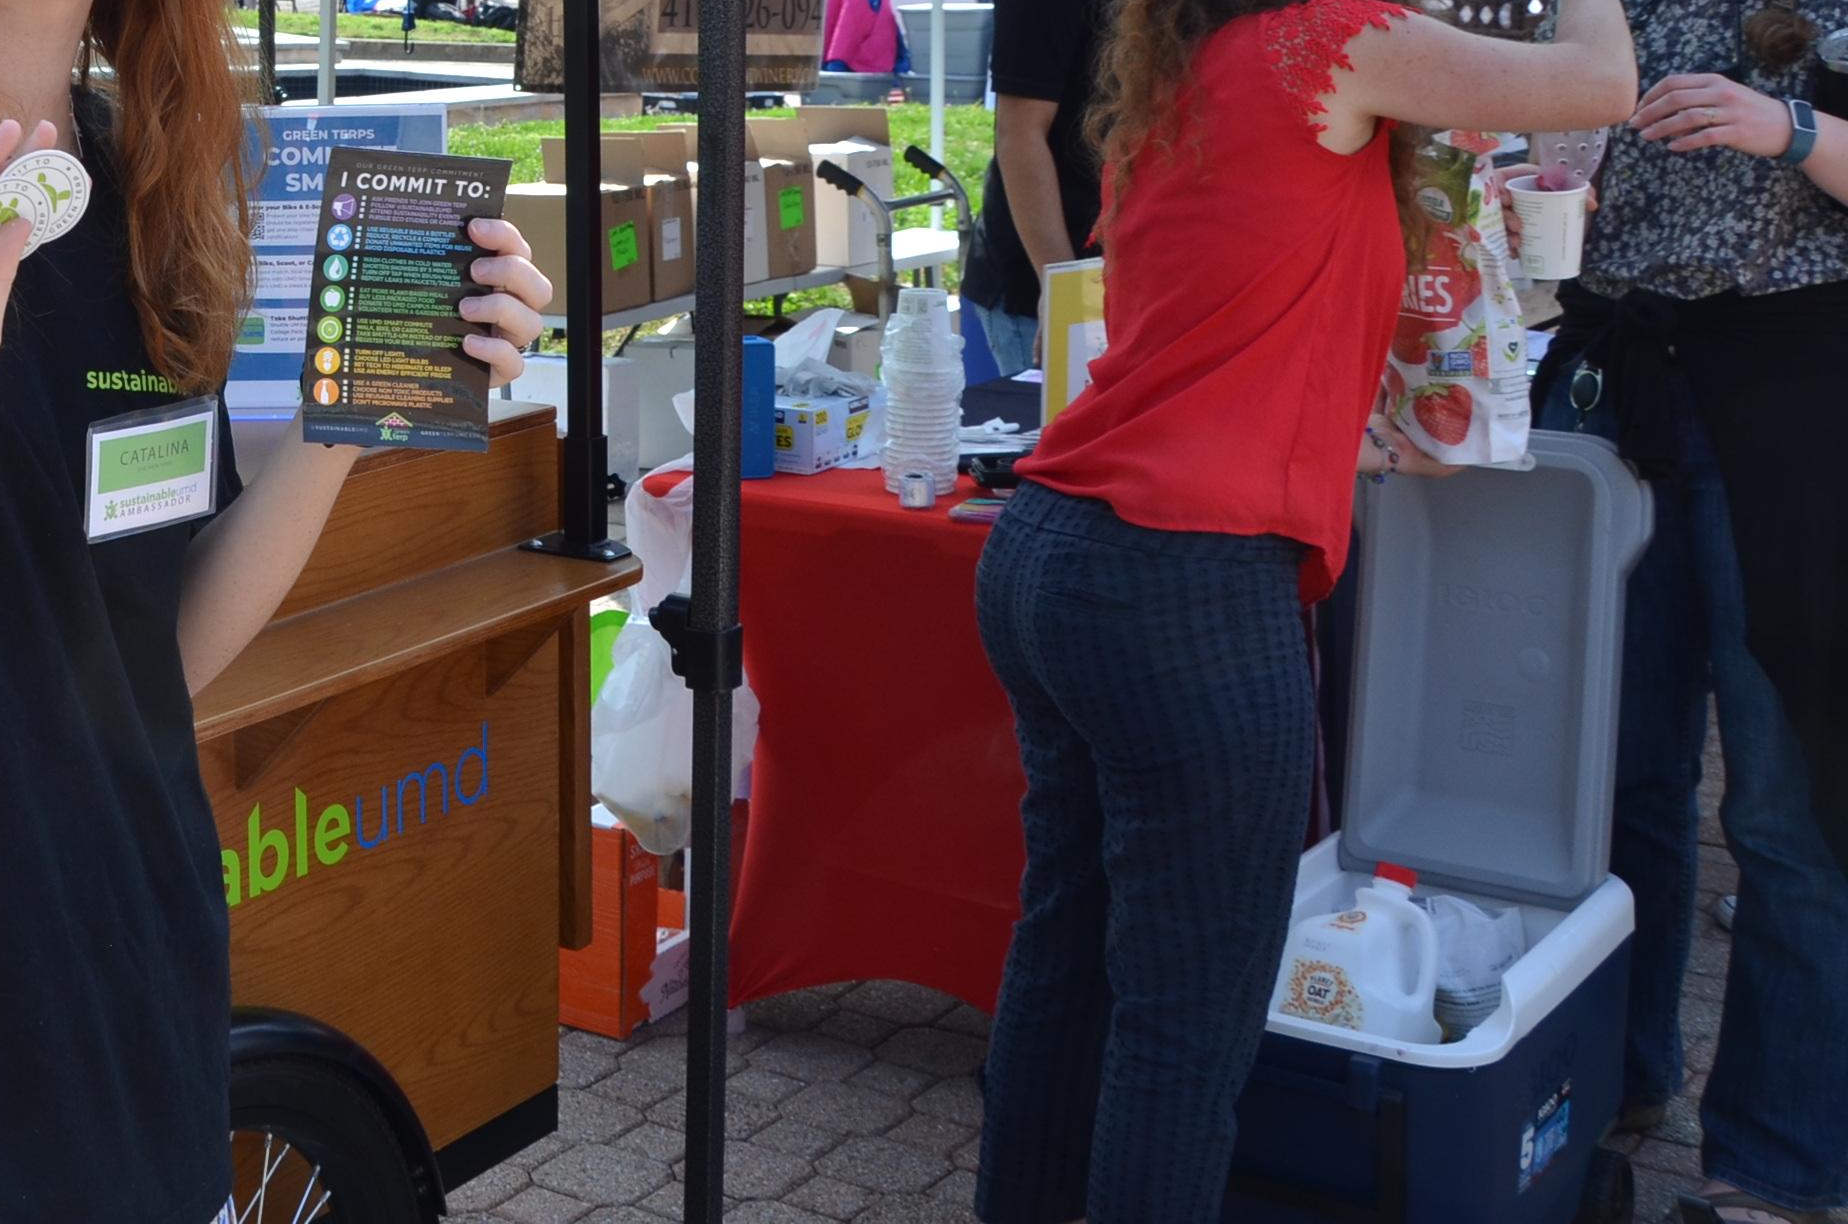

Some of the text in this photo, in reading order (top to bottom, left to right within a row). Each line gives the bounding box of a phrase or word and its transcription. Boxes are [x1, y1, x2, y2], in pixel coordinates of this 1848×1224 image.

[282, 128, 376, 141] GREEN TERPS
[16, 182, 29, 192] TO
[340, 171, 490, 197] I COMMIT TO:
[86, 369, 179, 394] sustainab
[119, 439, 190, 466] CATALINA
[119, 480, 198, 509] sustainableumd
[119, 495, 192, 519] AMBASSADOR
[1307, 985, 1331, 999] OAT
